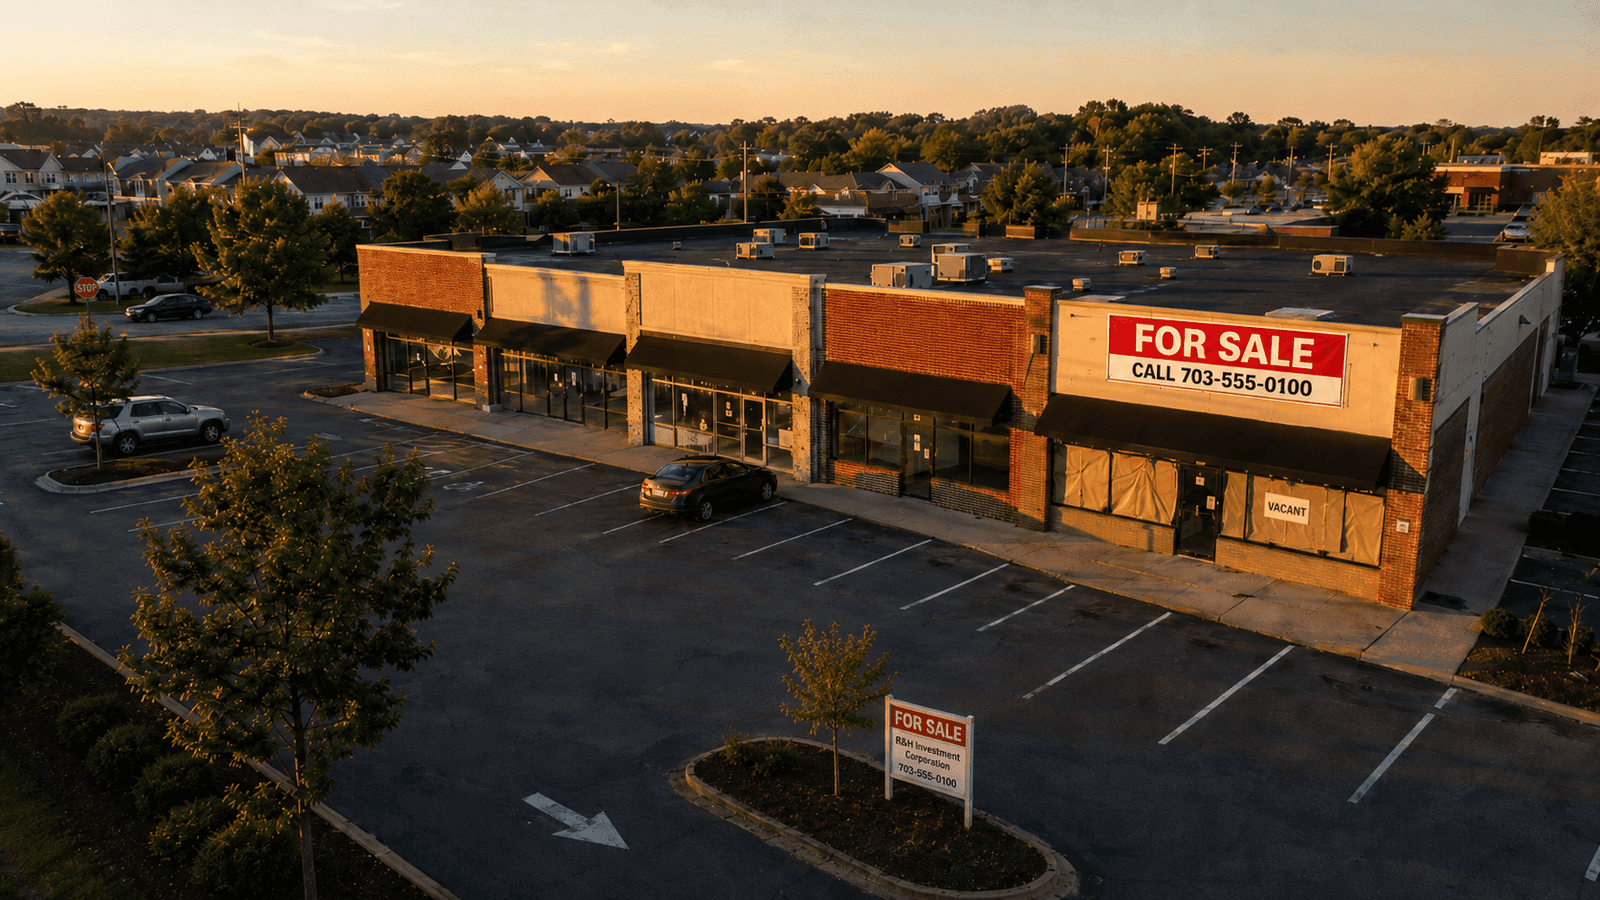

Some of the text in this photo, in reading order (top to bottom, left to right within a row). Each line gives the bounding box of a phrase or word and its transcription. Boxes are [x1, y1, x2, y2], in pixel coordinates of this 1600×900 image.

[77, 283, 97, 292] STOP
[1135, 322, 1315, 369] FOR SALE
[1132, 362, 1312, 397] CALL 703-555-0100
[1268, 501, 1307, 517] VACANT
[895, 709, 962, 742] FOR SALE
[895, 735, 960, 762] R&H Investment
[904, 750, 950, 770] Corporation
[898, 763, 957, 788] 703-555-0100
